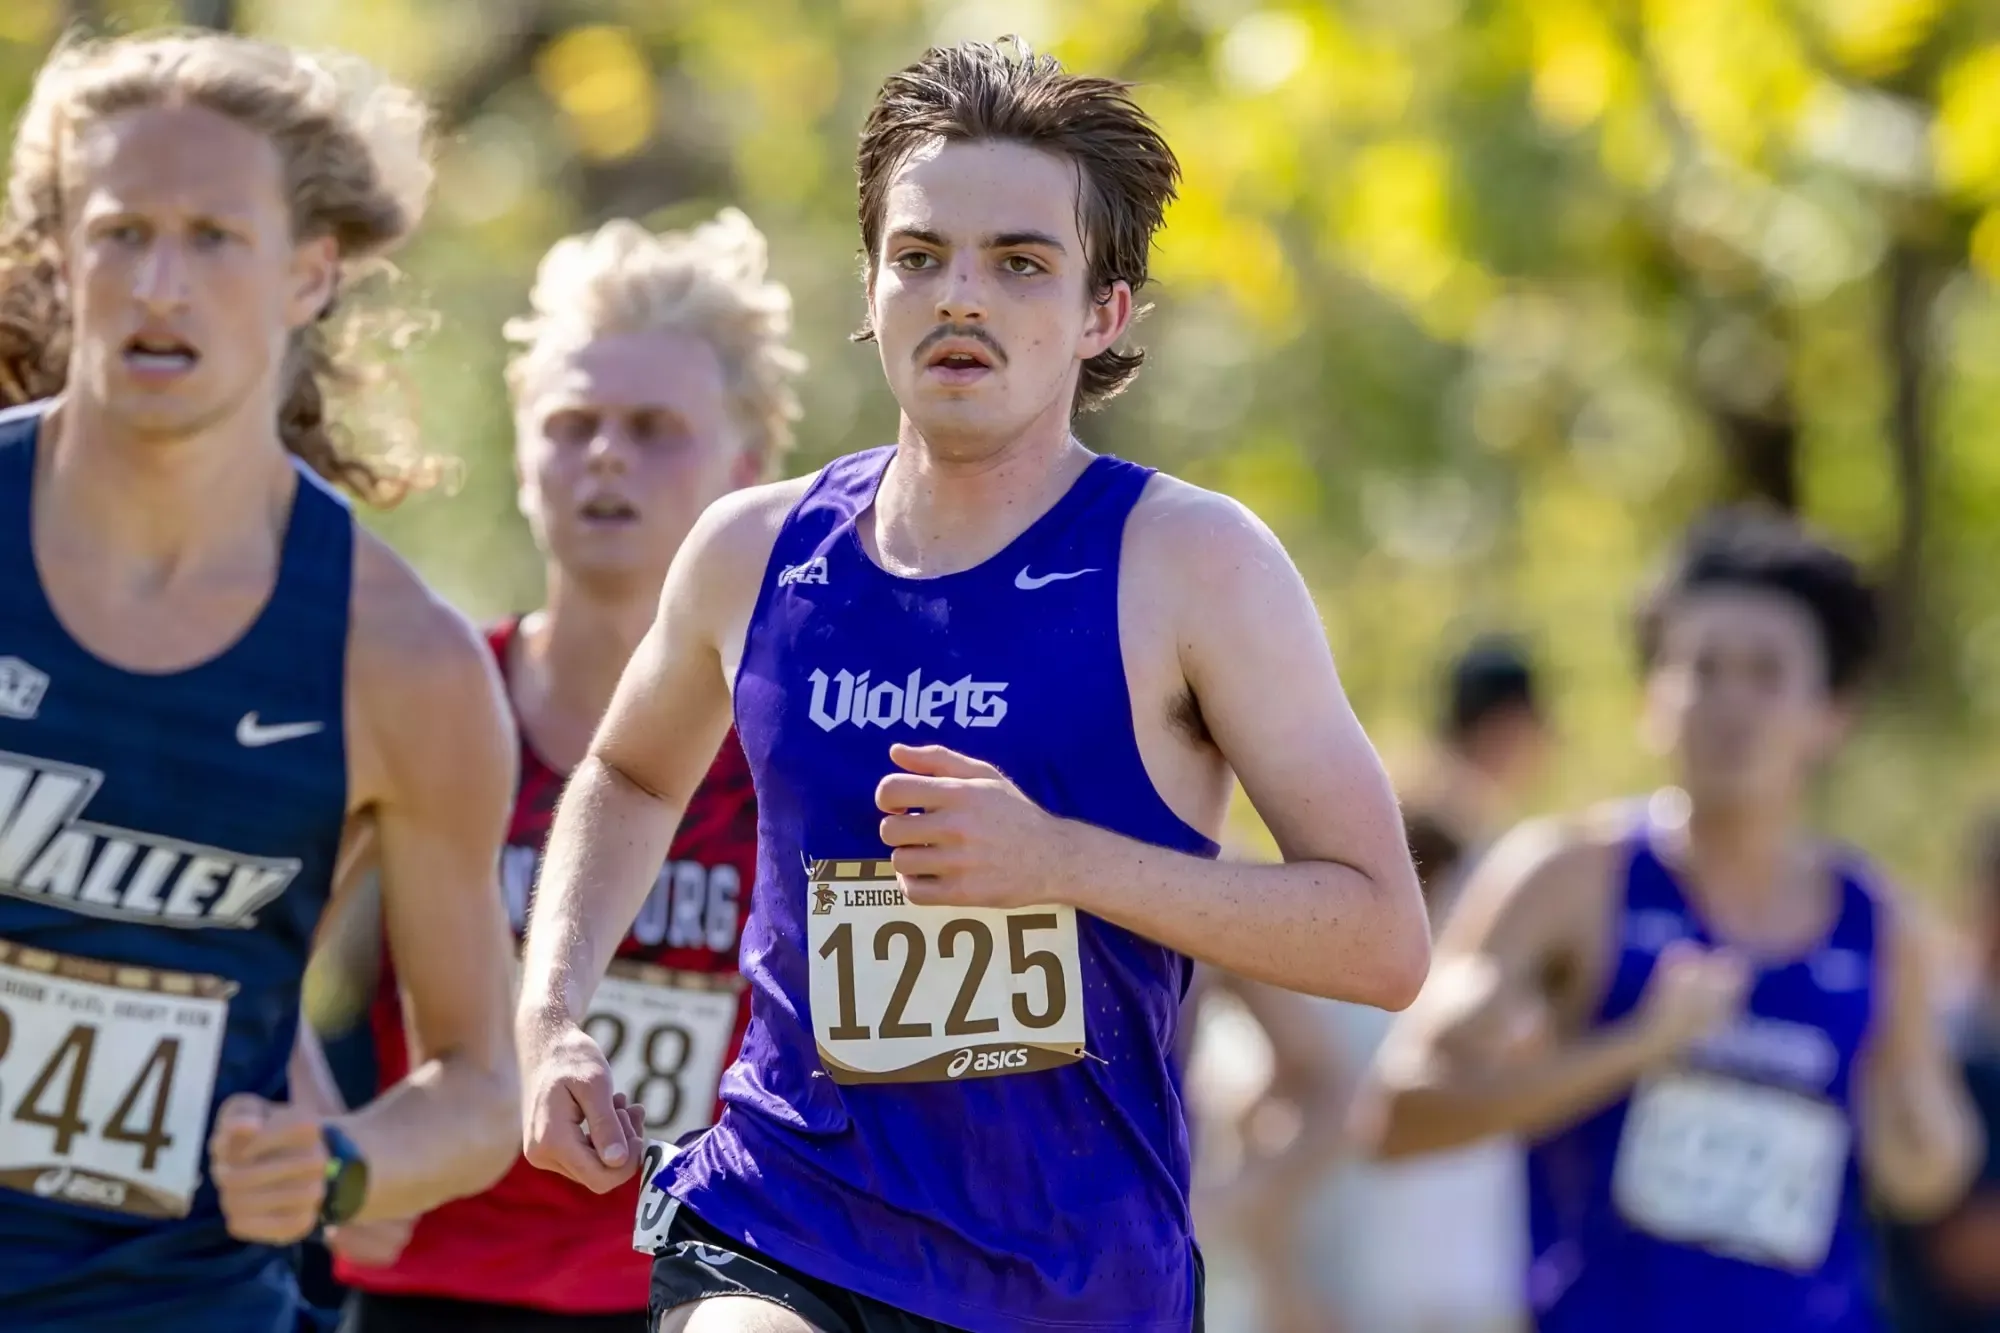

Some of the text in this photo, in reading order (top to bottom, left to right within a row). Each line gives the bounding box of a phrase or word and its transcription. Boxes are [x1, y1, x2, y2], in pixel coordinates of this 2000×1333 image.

[807, 667, 1009, 732] Violets
[844, 889, 905, 907] LEHIGH
[818, 913, 1066, 1040] 1225
[0, 1006, 180, 1172] 44
